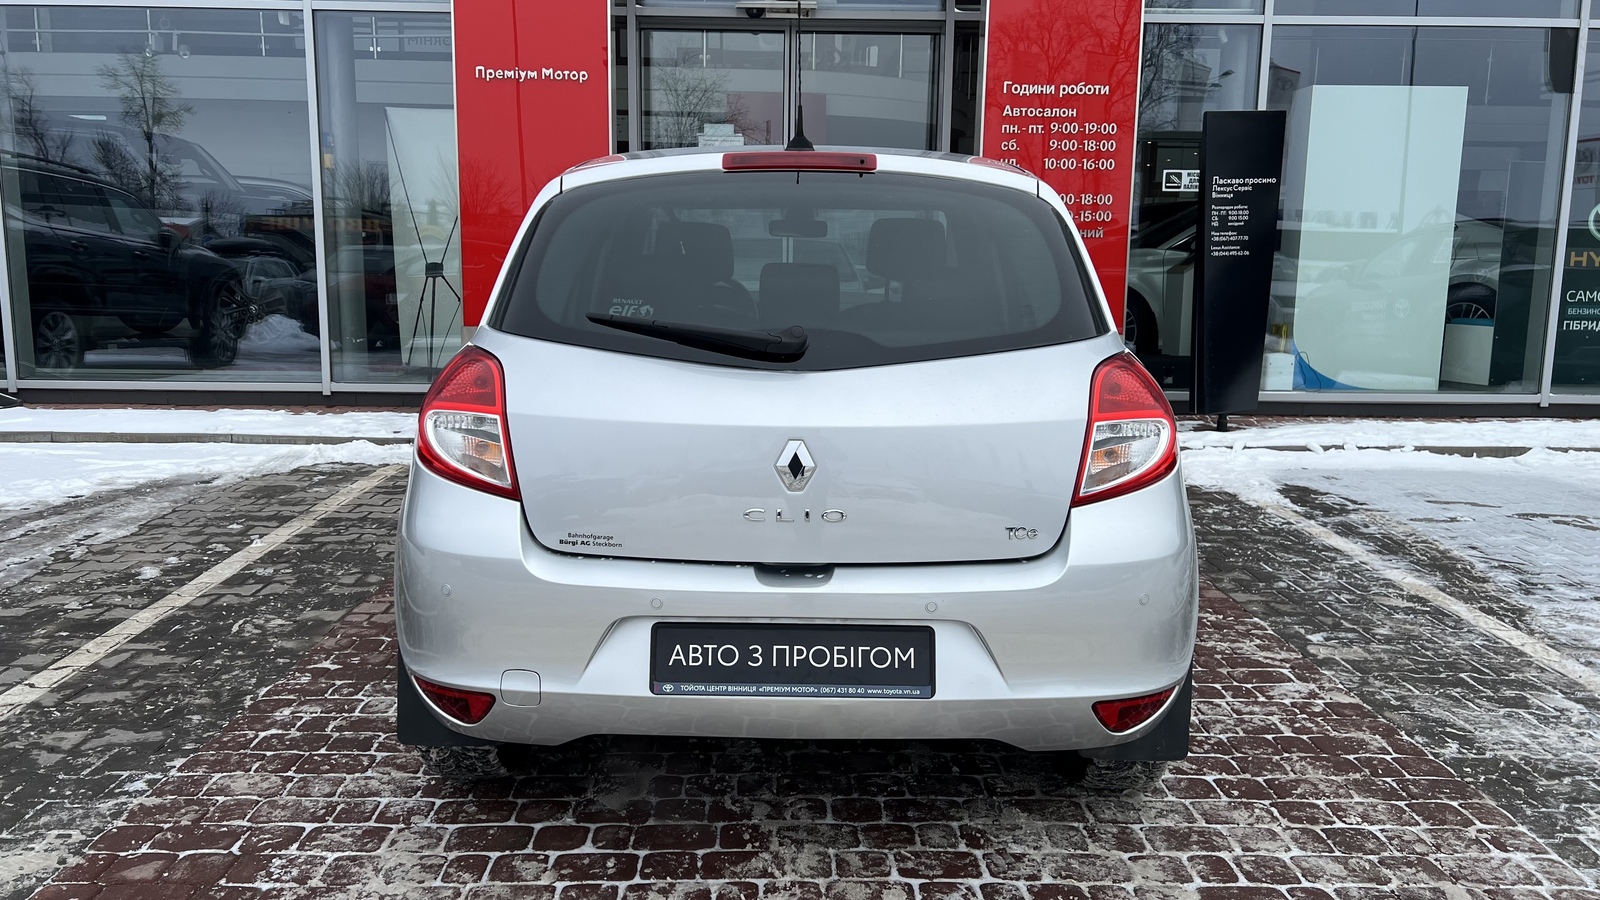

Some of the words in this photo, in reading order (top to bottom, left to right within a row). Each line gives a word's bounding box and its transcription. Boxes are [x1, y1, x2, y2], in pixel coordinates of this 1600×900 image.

[475, 65, 538, 82] Преміум
[541, 67, 589, 83] Мотор
[1003, 81, 1055, 96] Години
[1059, 82, 1110, 98] роботи
[1002, 105, 1077, 118] Автосалон
[1050, 122, 1118, 135] 9:00-19:00
[1001, 139, 1020, 151] сб.
[1049, 139, 1117, 152] 9:00-18:00
[1043, 158, 1115, 171] 10:00-16:00
[1212, 176, 1244, 185] Ласкаво
[1245, 177, 1277, 186] просимо
[1212, 184, 1233, 192] Лексус
[1566, 290, 1600, 303] САМ
[608, 305, 638, 317] elf
[743, 508, 848, 523] CLIO
[567, 532, 614, 541] Bahnhofgarage
[1004, 526, 1039, 541] TCe
[668, 644, 739, 667] АВТО
[772, 645, 915, 669] ПРОБІГОМ
[680, 684, 706, 692] ТОЙОТА
[706, 685, 727, 693] ЦЕНТР
[727, 685, 757, 693] ВІННИЦЯ
[820, 687, 836, 695] (067)
[866, 687, 921, 696] www.toyota.vn.ua
